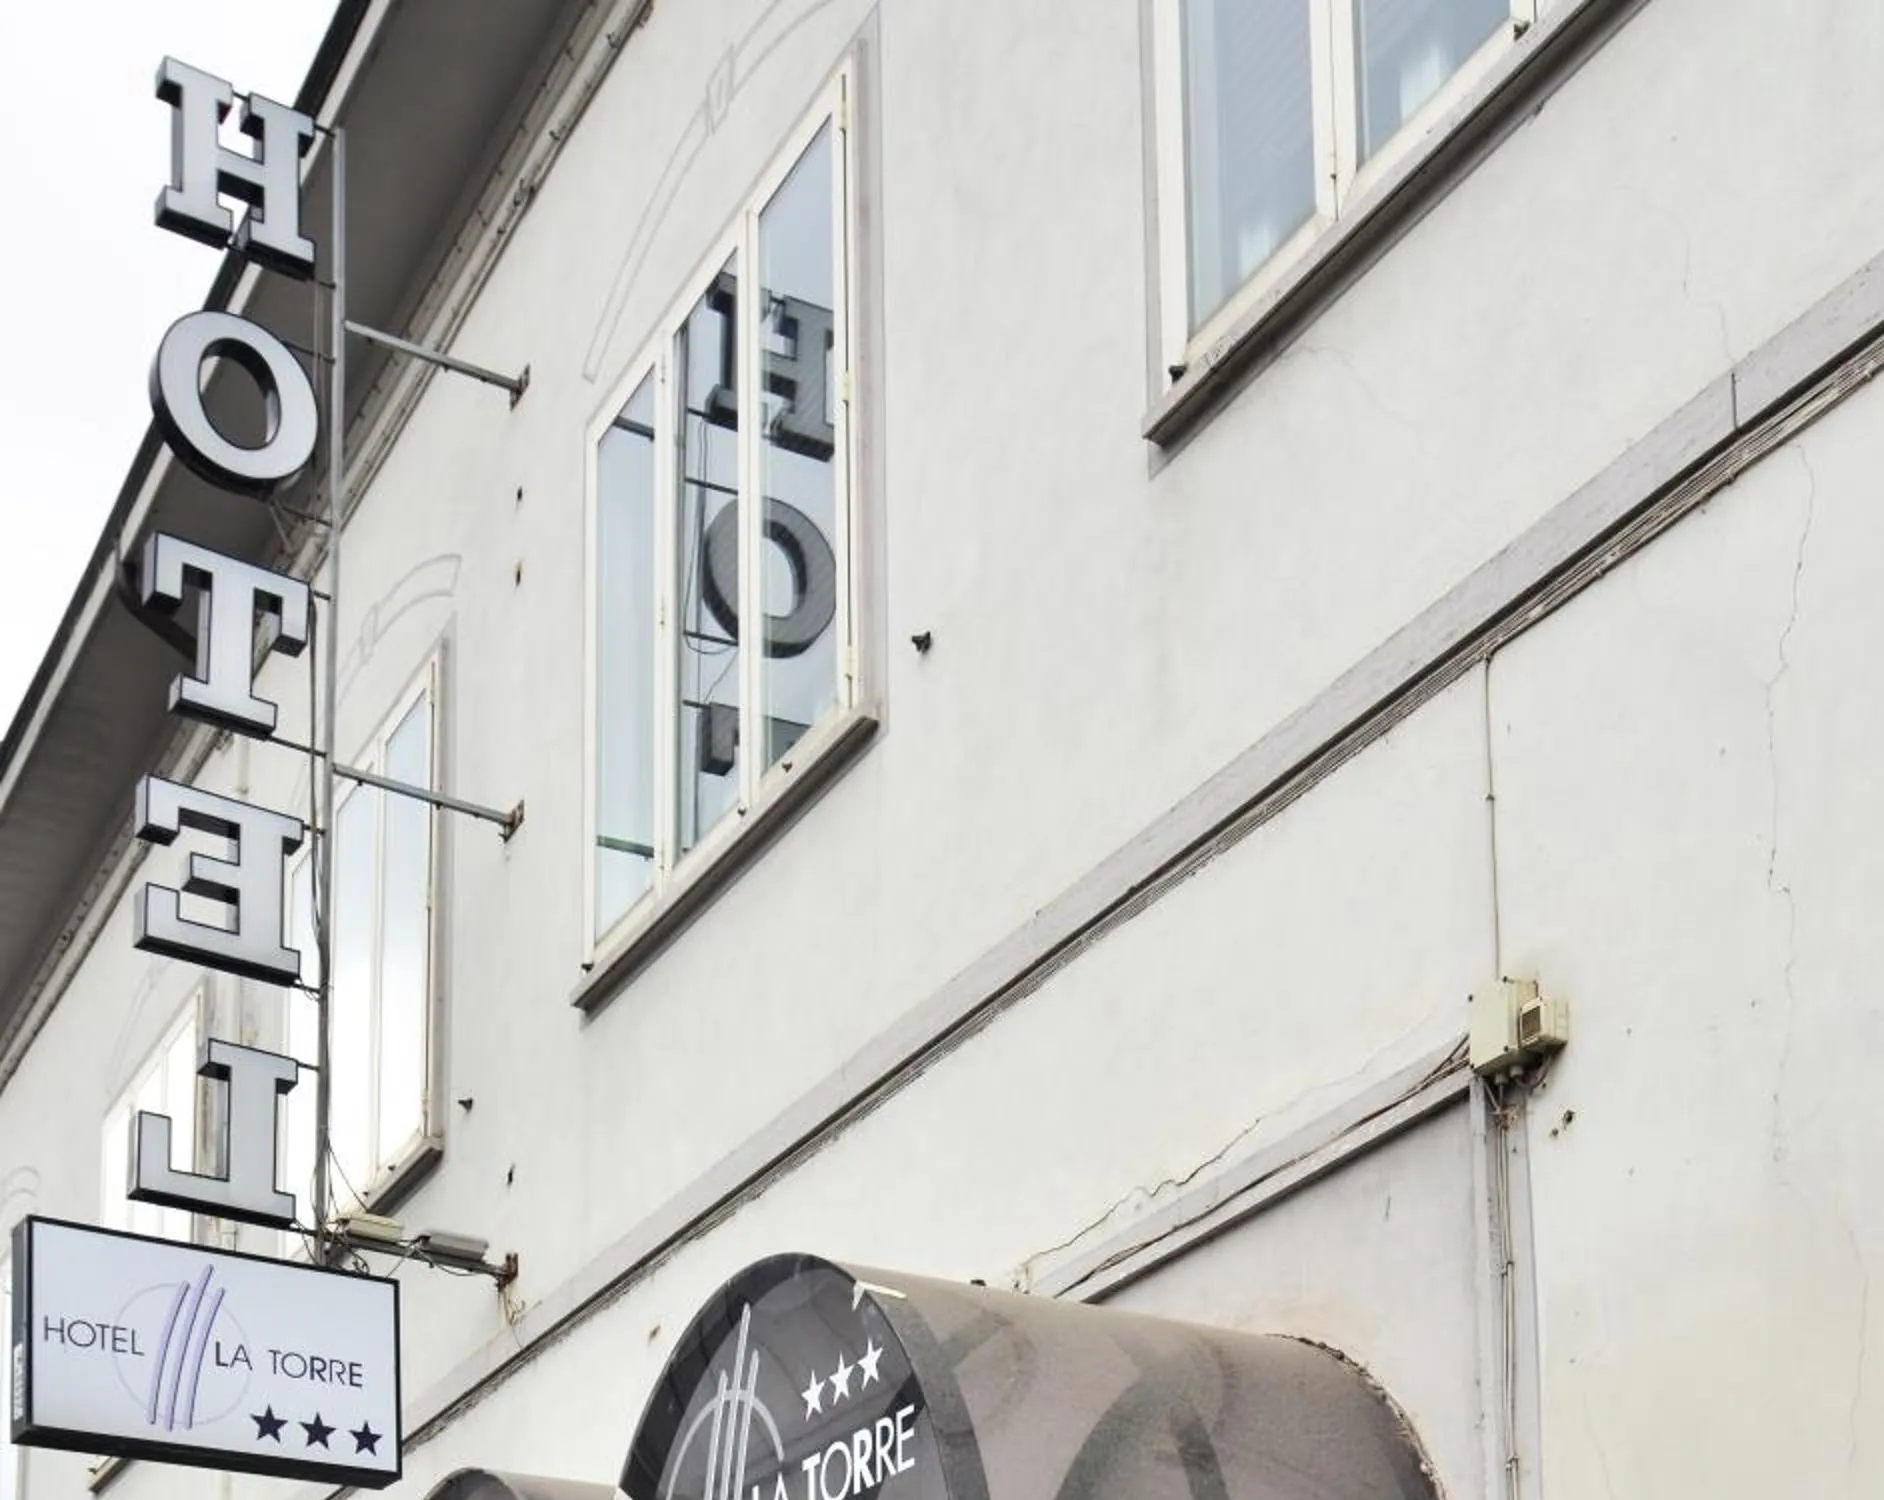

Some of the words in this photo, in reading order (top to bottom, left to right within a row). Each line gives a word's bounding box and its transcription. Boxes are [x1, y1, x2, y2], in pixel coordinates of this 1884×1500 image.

[43, 1315, 145, 1357] HOTEL
[214, 1341, 253, 1371] LA
[268, 1349, 364, 1388] TORRE
